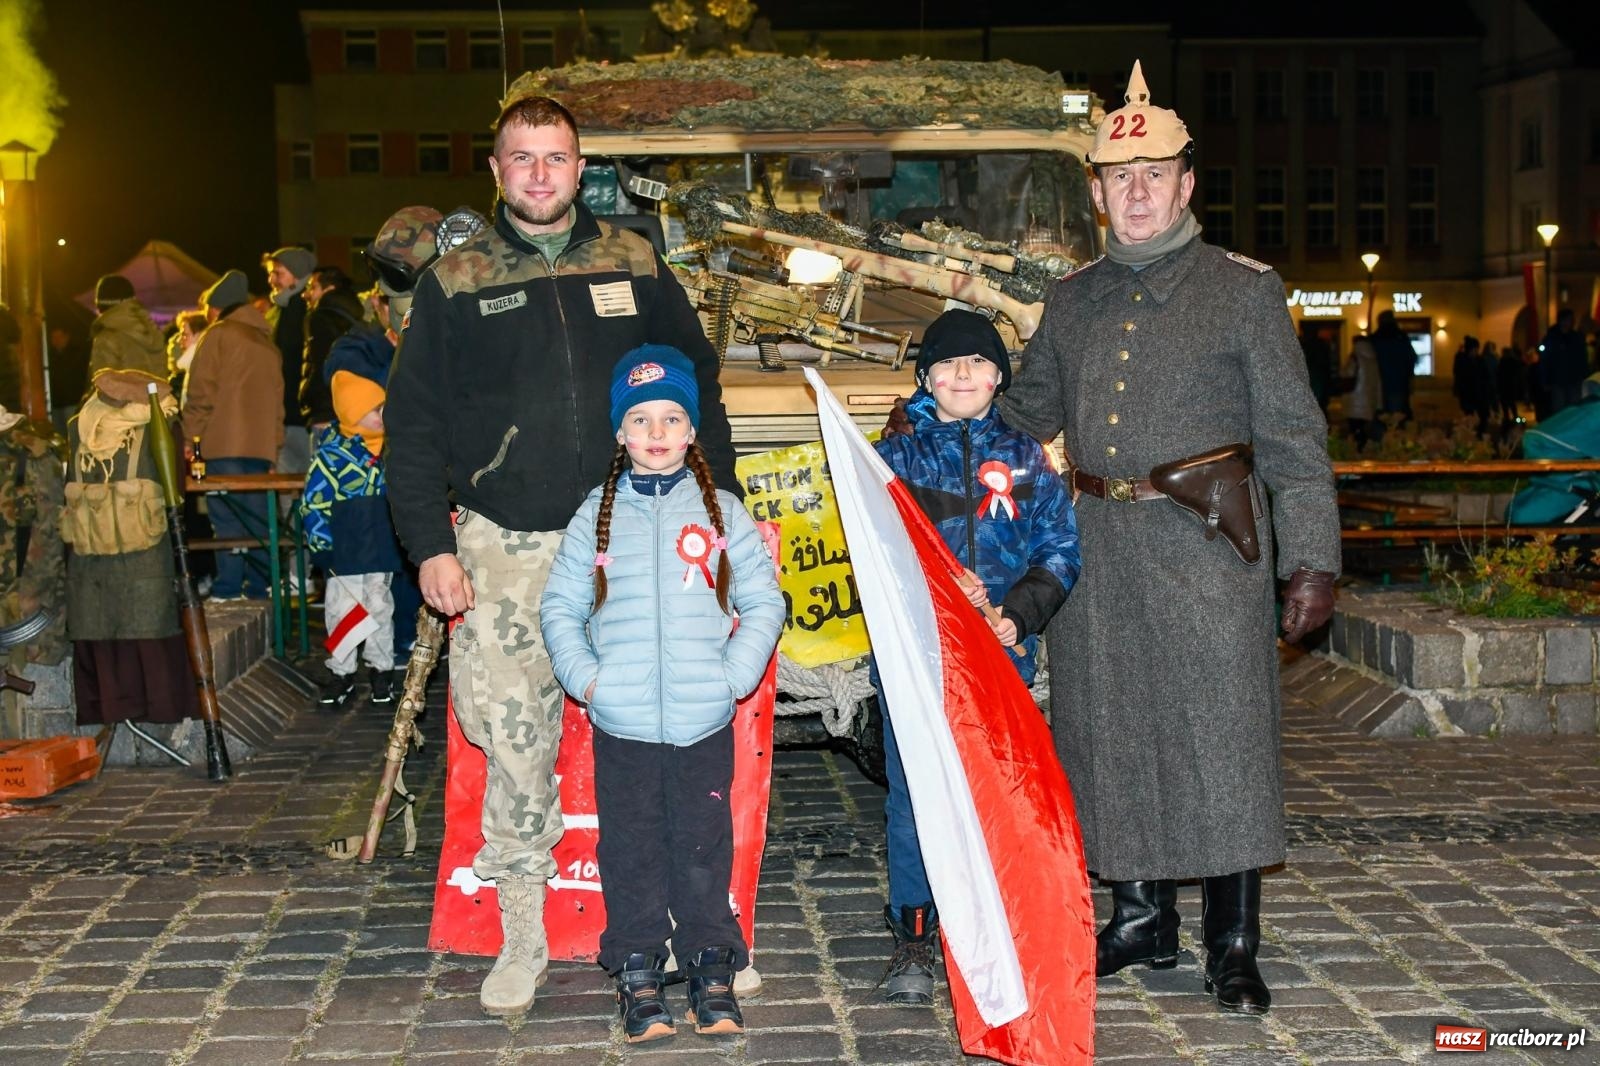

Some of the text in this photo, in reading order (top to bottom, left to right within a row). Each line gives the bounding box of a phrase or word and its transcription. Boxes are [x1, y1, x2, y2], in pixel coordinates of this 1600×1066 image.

[1110, 114, 1147, 140] 22
[486, 295, 520, 312] KUZERA
[1286, 289, 1363, 306] JUBILER
[746, 466, 812, 495] UTION
[752, 491, 823, 521] CK OR
[790, 536, 851, 572] سافة
[567, 860, 601, 880] 10
